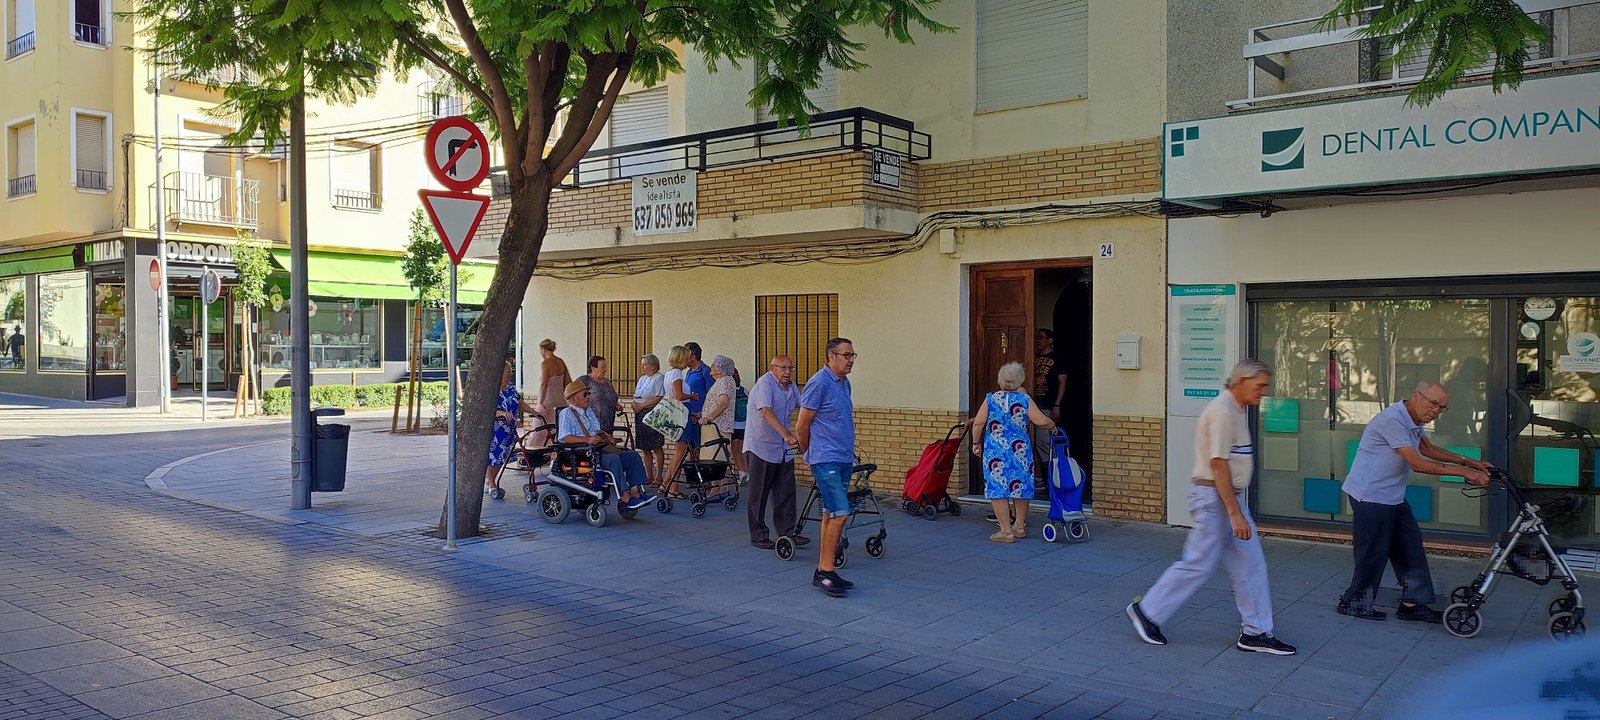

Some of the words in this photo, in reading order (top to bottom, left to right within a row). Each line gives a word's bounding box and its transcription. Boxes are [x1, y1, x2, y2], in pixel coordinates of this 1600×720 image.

[1322, 124, 1436, 157] DENTAL
[1444, 106, 1600, 145] COMPAN
[874, 151, 882, 162] SE
[882, 153, 900, 167] VENDE
[642, 177, 655, 188] Se
[656, 173, 687, 187] vende
[647, 189, 681, 201] idealista
[634, 205, 652, 231] 637
[655, 203, 673, 229] 050
[675, 201, 695, 227] 969
[93, 240, 125, 262] MILAR
[166, 241, 235, 263] ORDON
[1101, 244, 1113, 257] 24
